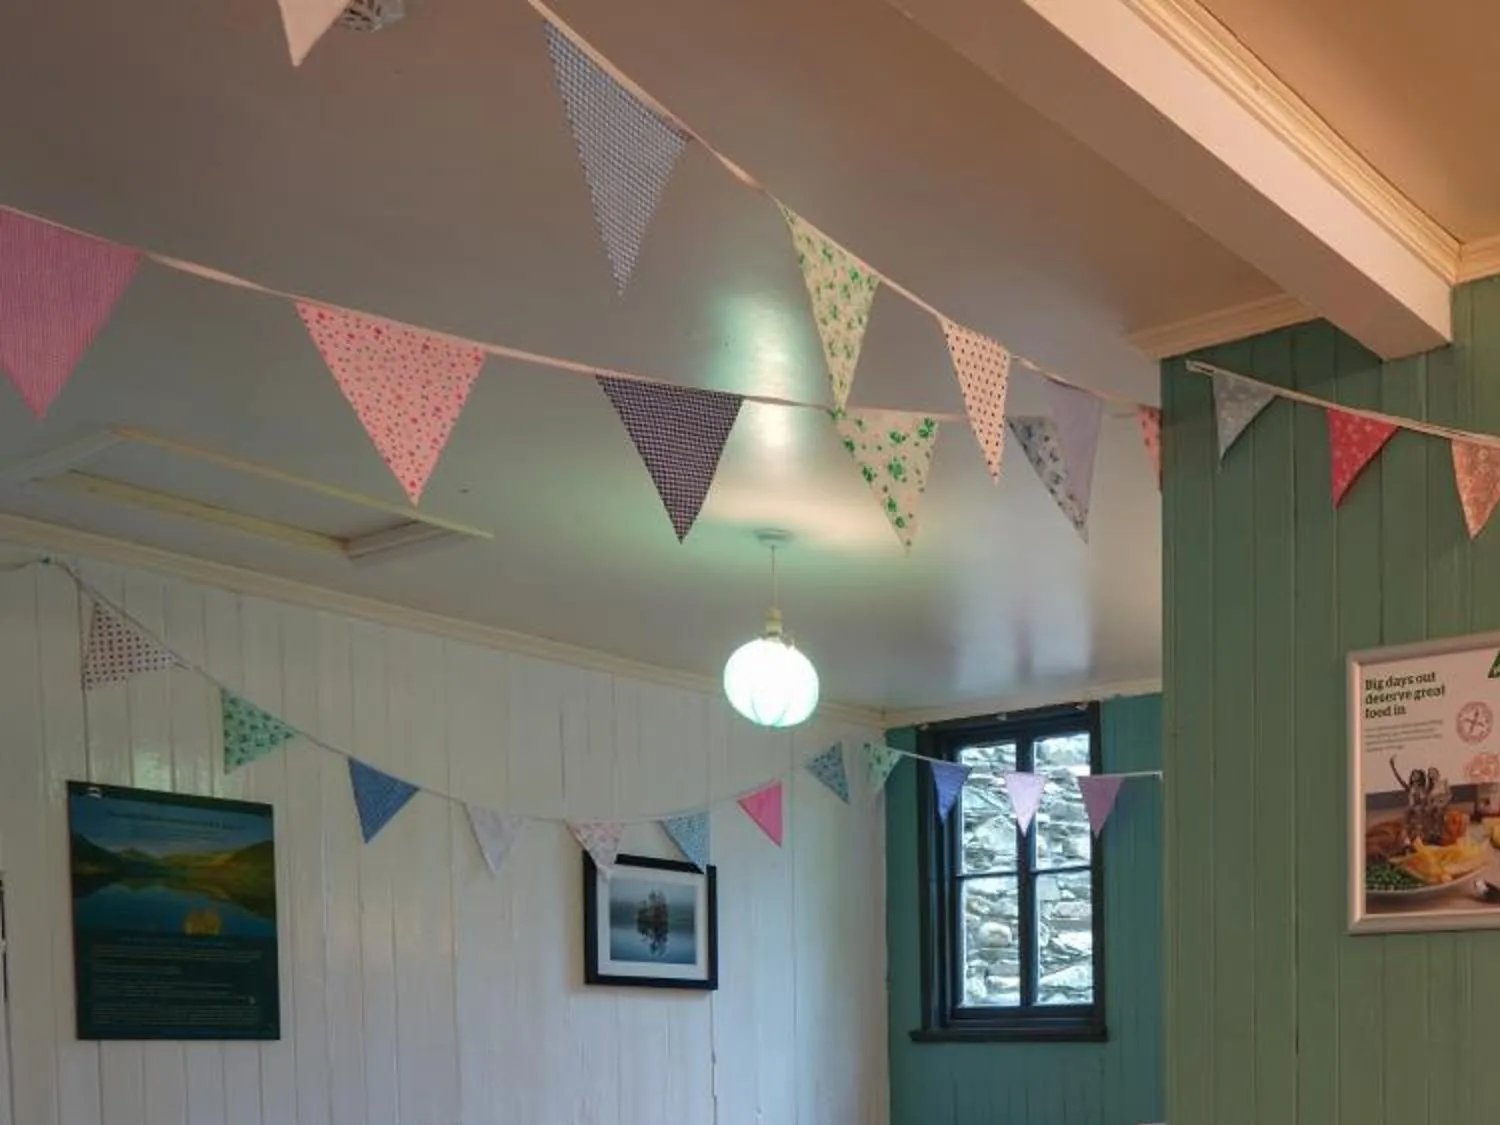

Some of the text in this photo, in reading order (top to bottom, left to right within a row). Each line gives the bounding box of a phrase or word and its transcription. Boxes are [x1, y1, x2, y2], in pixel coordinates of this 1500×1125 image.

[1365, 672, 1435, 691] Big days out
[1365, 684, 1445, 704] deserve great
[1365, 704, 1406, 718] food in
